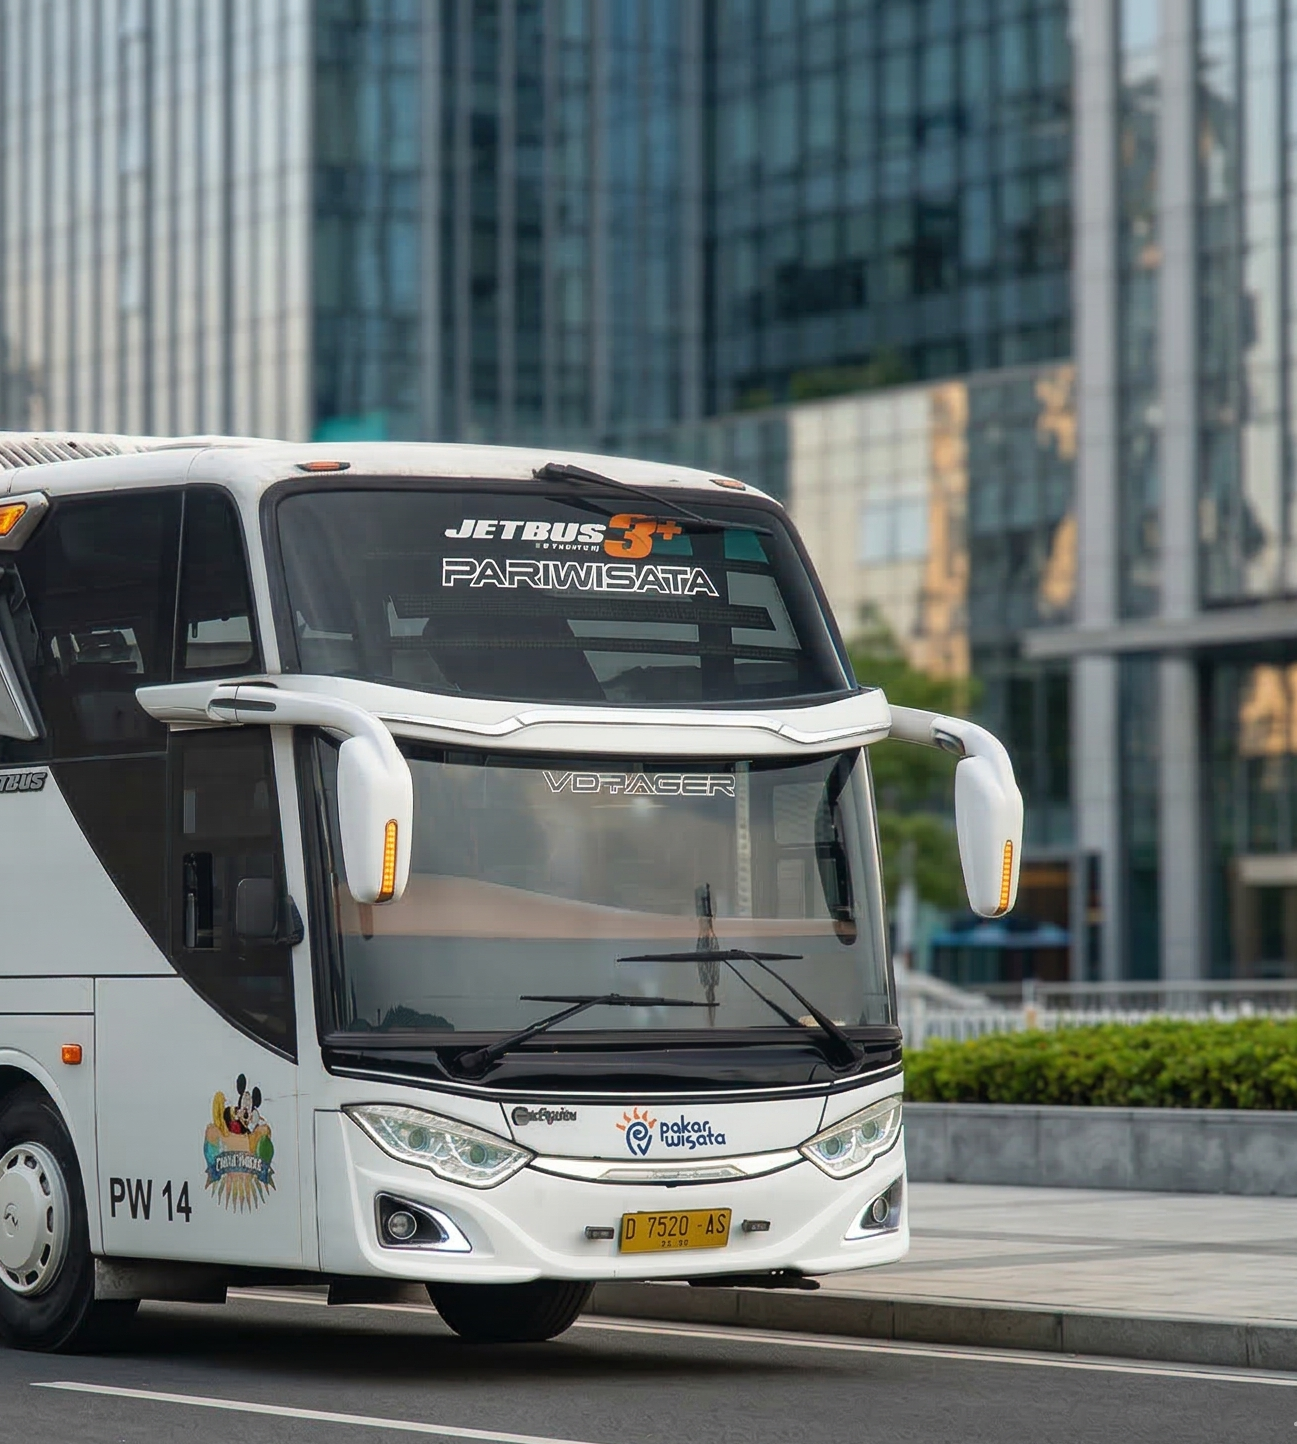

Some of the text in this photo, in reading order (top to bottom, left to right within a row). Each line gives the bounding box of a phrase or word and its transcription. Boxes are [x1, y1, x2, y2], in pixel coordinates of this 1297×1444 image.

[445, 519, 607, 543] JETBUS
[442, 558, 719, 597] PARIWISATA
[660, 1114, 710, 1142] pakar
[665, 1126, 727, 1150] wisata
[109, 1177, 192, 1223] PW 14
[625, 1218, 636, 1240] D
[648, 1215, 689, 1238] 7520
